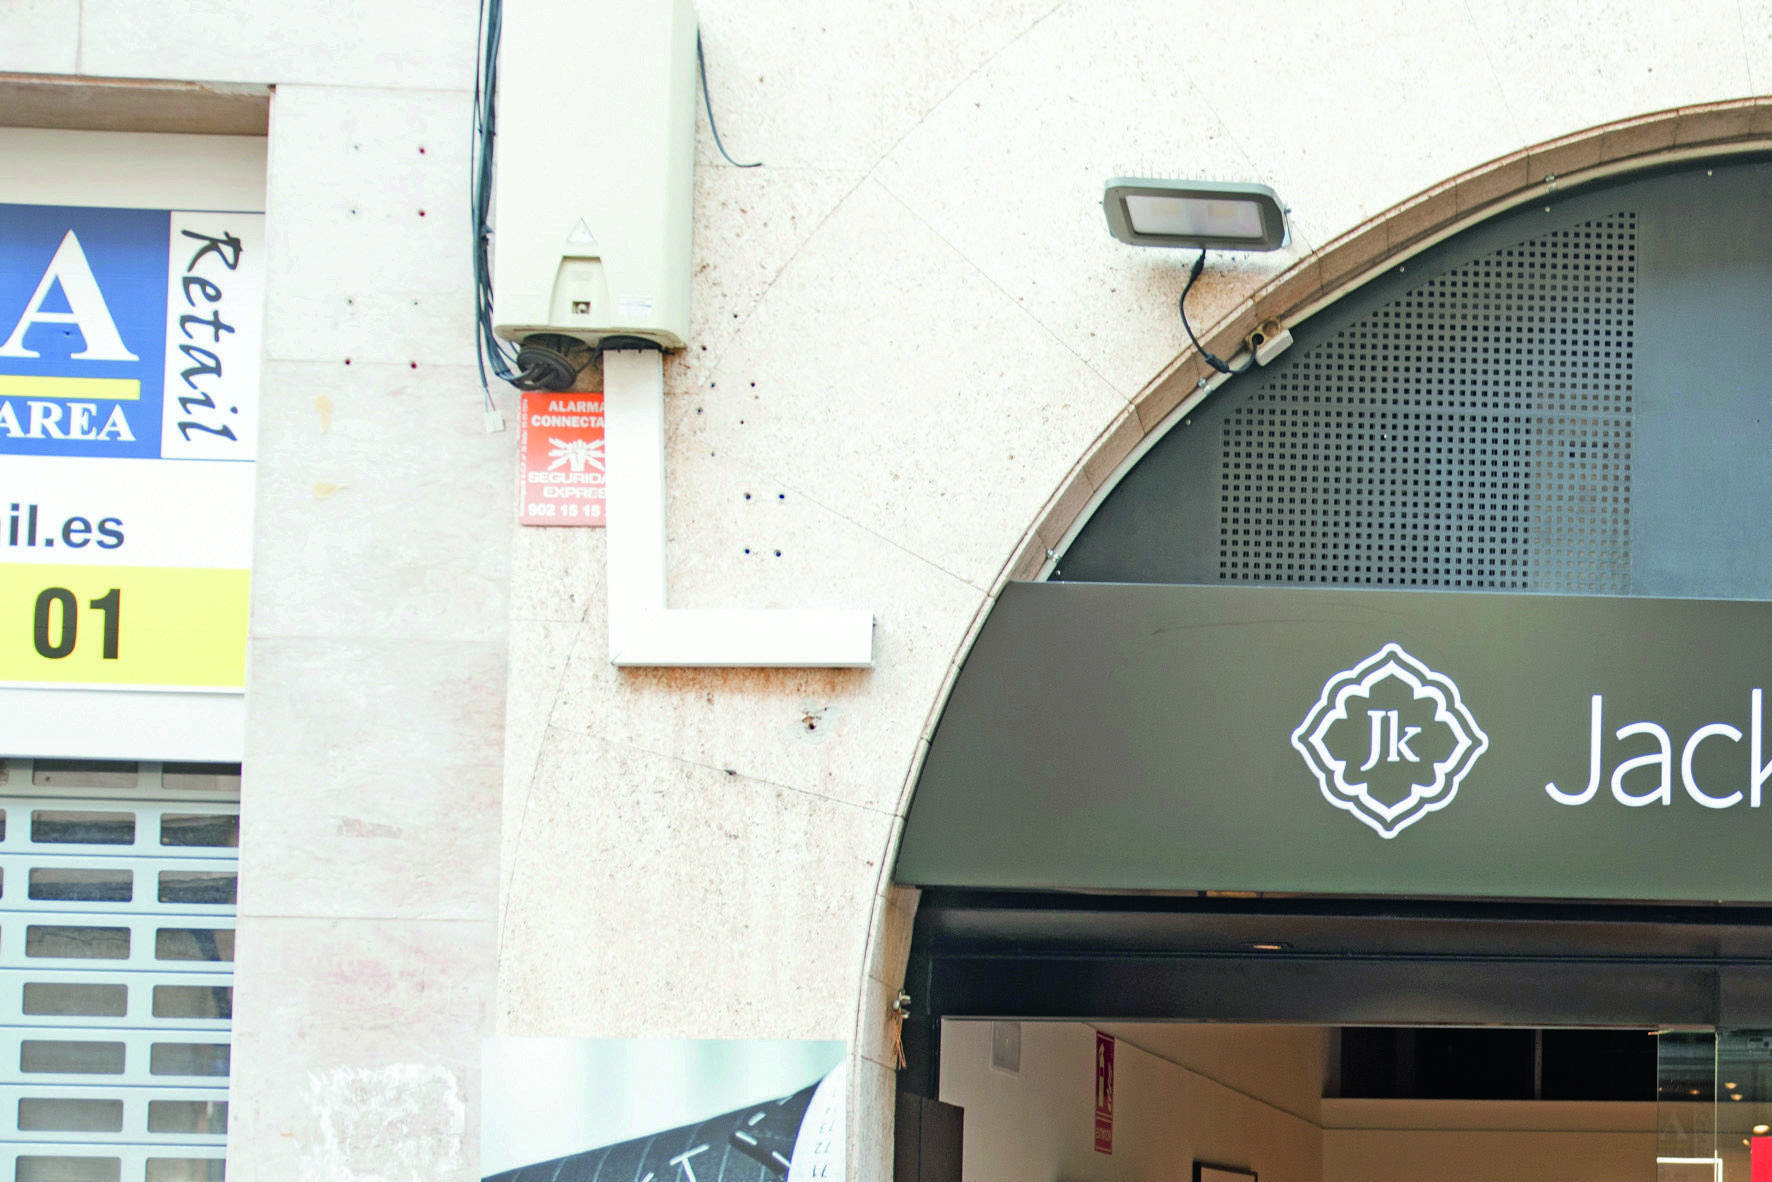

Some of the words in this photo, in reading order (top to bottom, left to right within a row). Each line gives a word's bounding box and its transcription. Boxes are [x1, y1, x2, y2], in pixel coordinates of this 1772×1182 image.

[0, 229, 140, 361] A
[179, 229, 243, 443] Retail
[0, 400, 136, 441] AREA
[528, 503, 556, 516] 902
[33, 587, 121, 659] 01
[1361, 709, 1424, 771] Jk
